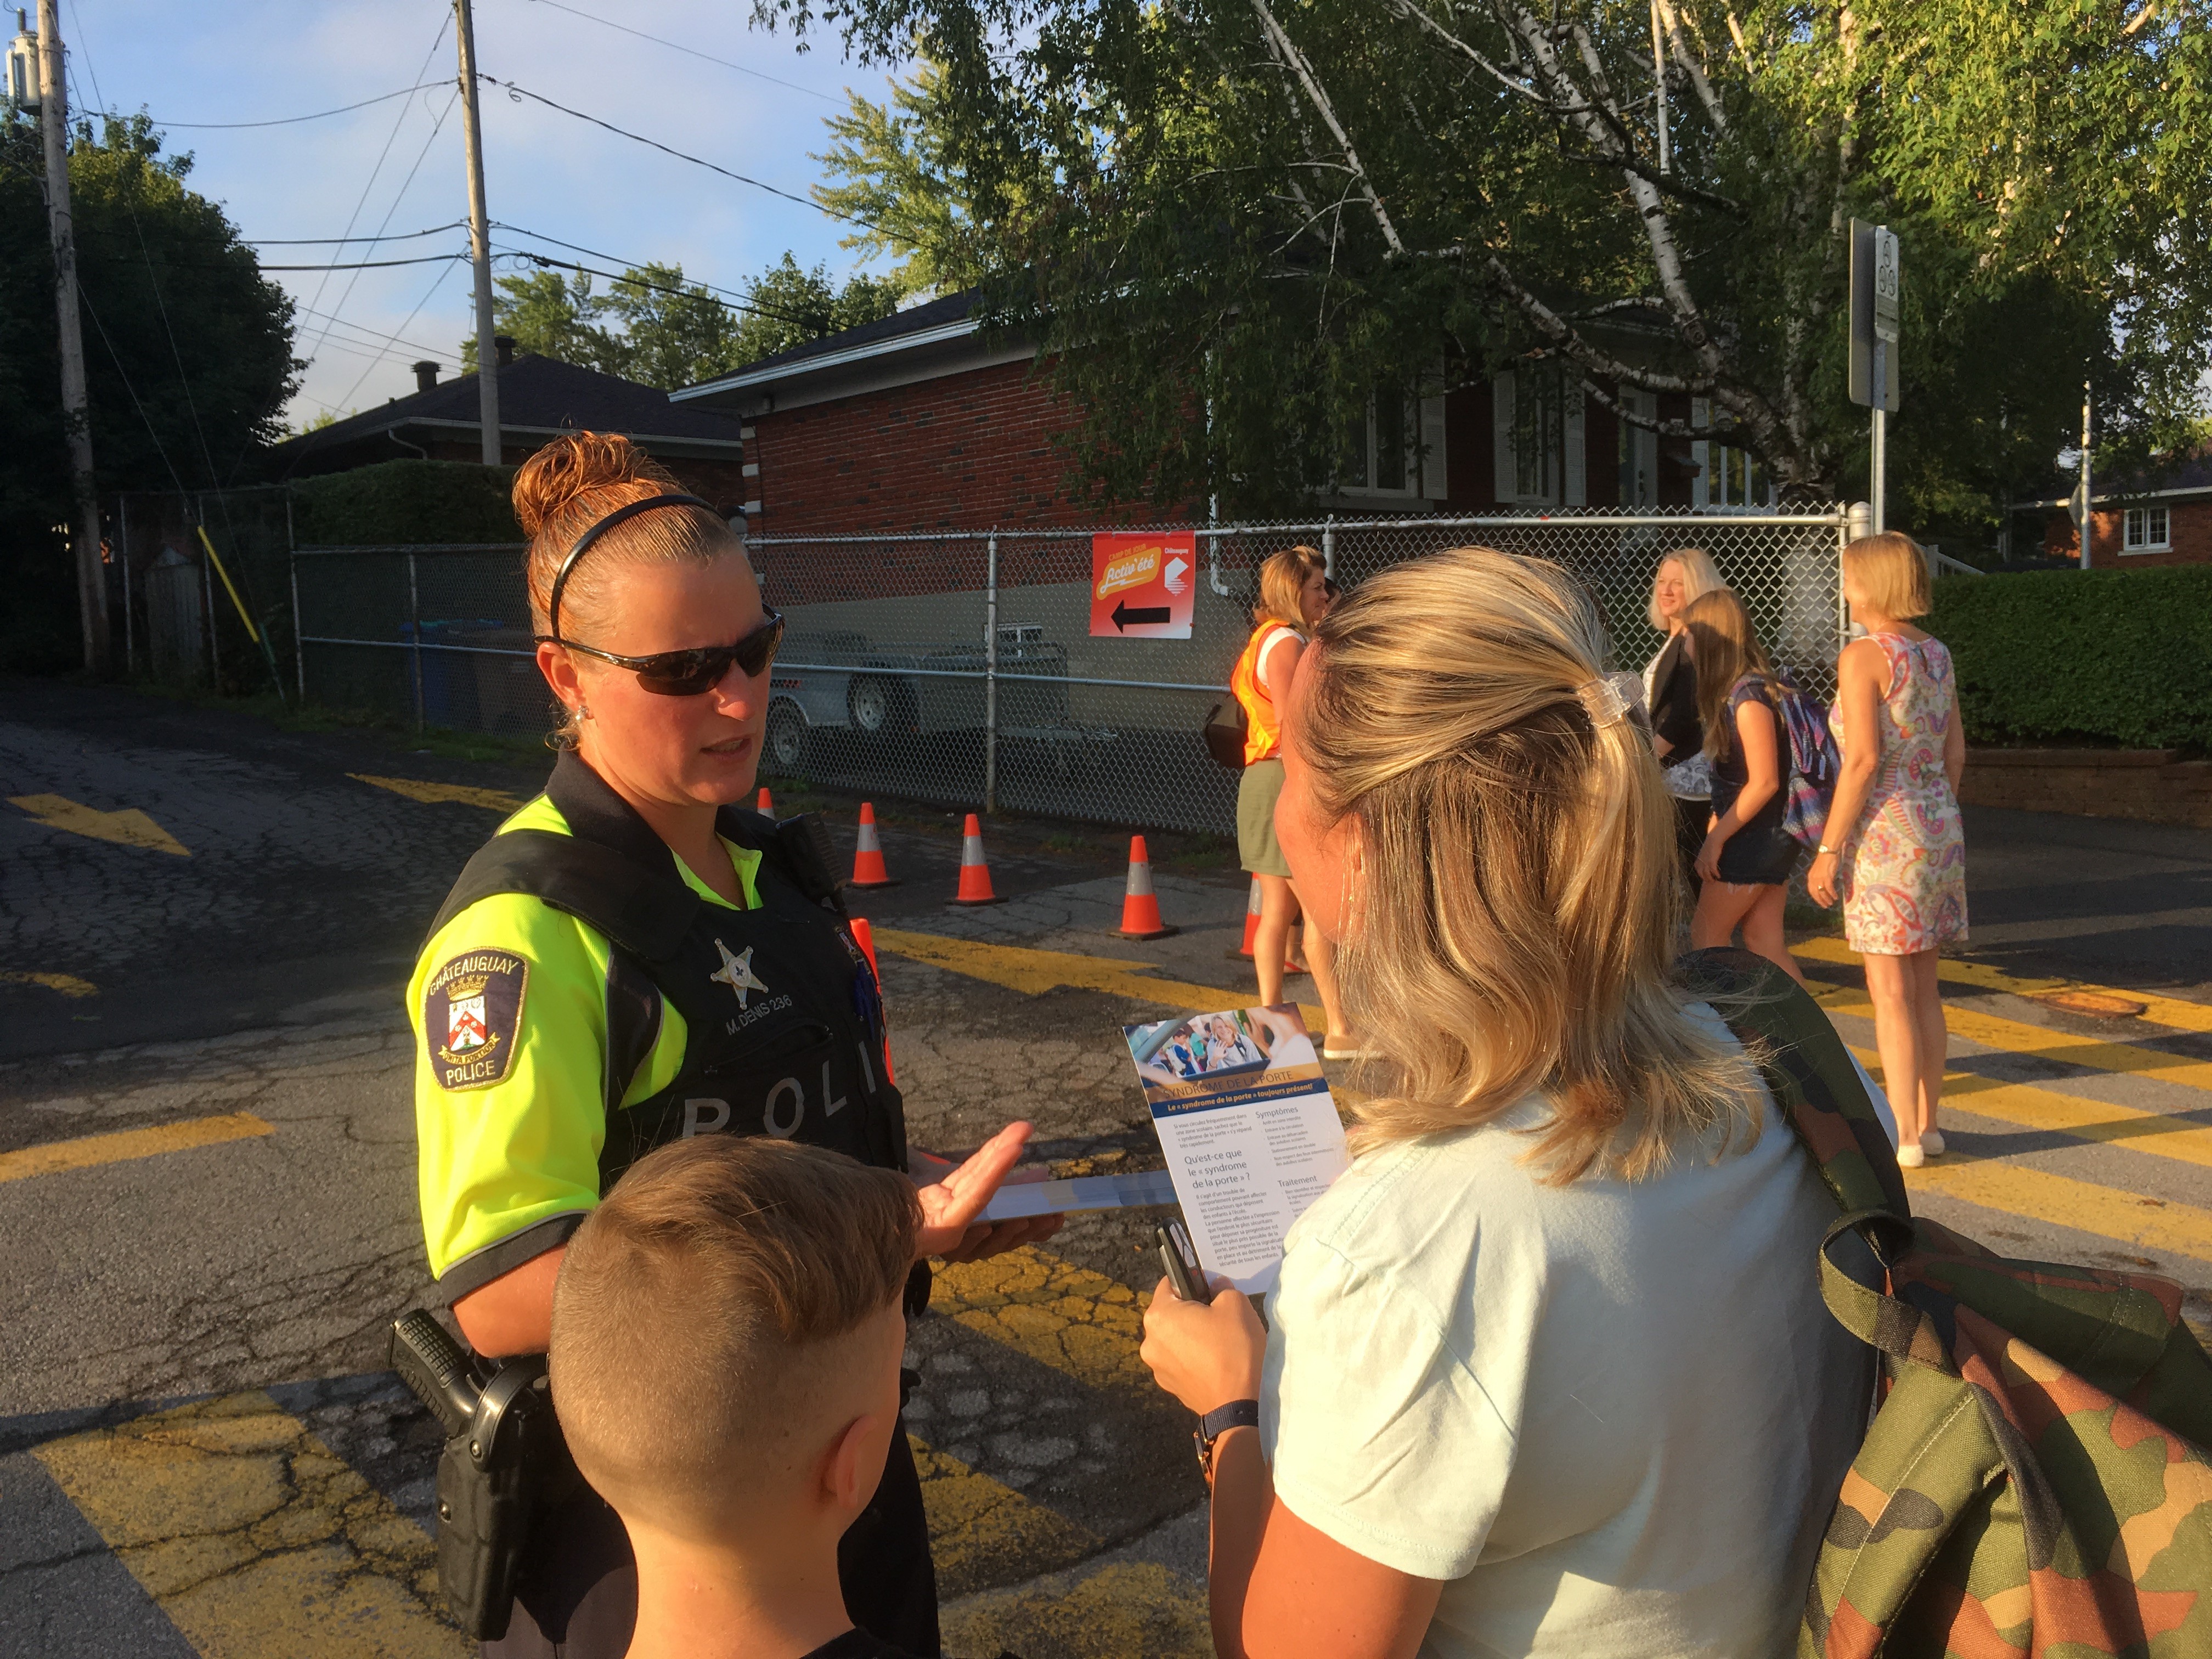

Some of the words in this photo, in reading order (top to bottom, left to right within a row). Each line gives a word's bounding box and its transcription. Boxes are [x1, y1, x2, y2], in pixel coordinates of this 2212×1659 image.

[1109, 550, 1124, 561] CAMP
[1124, 548, 1132, 556] DE
[1132, 543, 1147, 553] JOUR
[429, 956, 520, 996] CHÂTEAUGUAY
[738, 1002, 770, 1027] DENIS
[769, 994, 792, 1011] 236
[446, 1059, 496, 1086] POLICE
[682, 1025, 888, 1139] POLI
[1164, 1081, 1223, 1098] SYNDROME
[1227, 1079, 1241, 1088] DE
[1243, 1076, 1257, 1086] LA
[1259, 1071, 1294, 1084] PORTE
[1182, 1099, 1215, 1110] syndrome
[1233, 1093, 1251, 1102] porte
[1257, 1088, 1285, 1097] toujours
[1255, 1107, 1298, 1119] Symptômes
[1184, 1153, 1223, 1164] Qu'est-ce
[1226, 1150, 1242, 1159] que
[1188, 1168, 1197, 1176] le
[1204, 1162, 1246, 1175] syndrome
[1192, 1180, 1204, 1188] de
[1204, 1178, 1213, 1187] la
[1215, 1176, 1238, 1187] porte
[1277, 1175, 1317, 1187] Traitement
